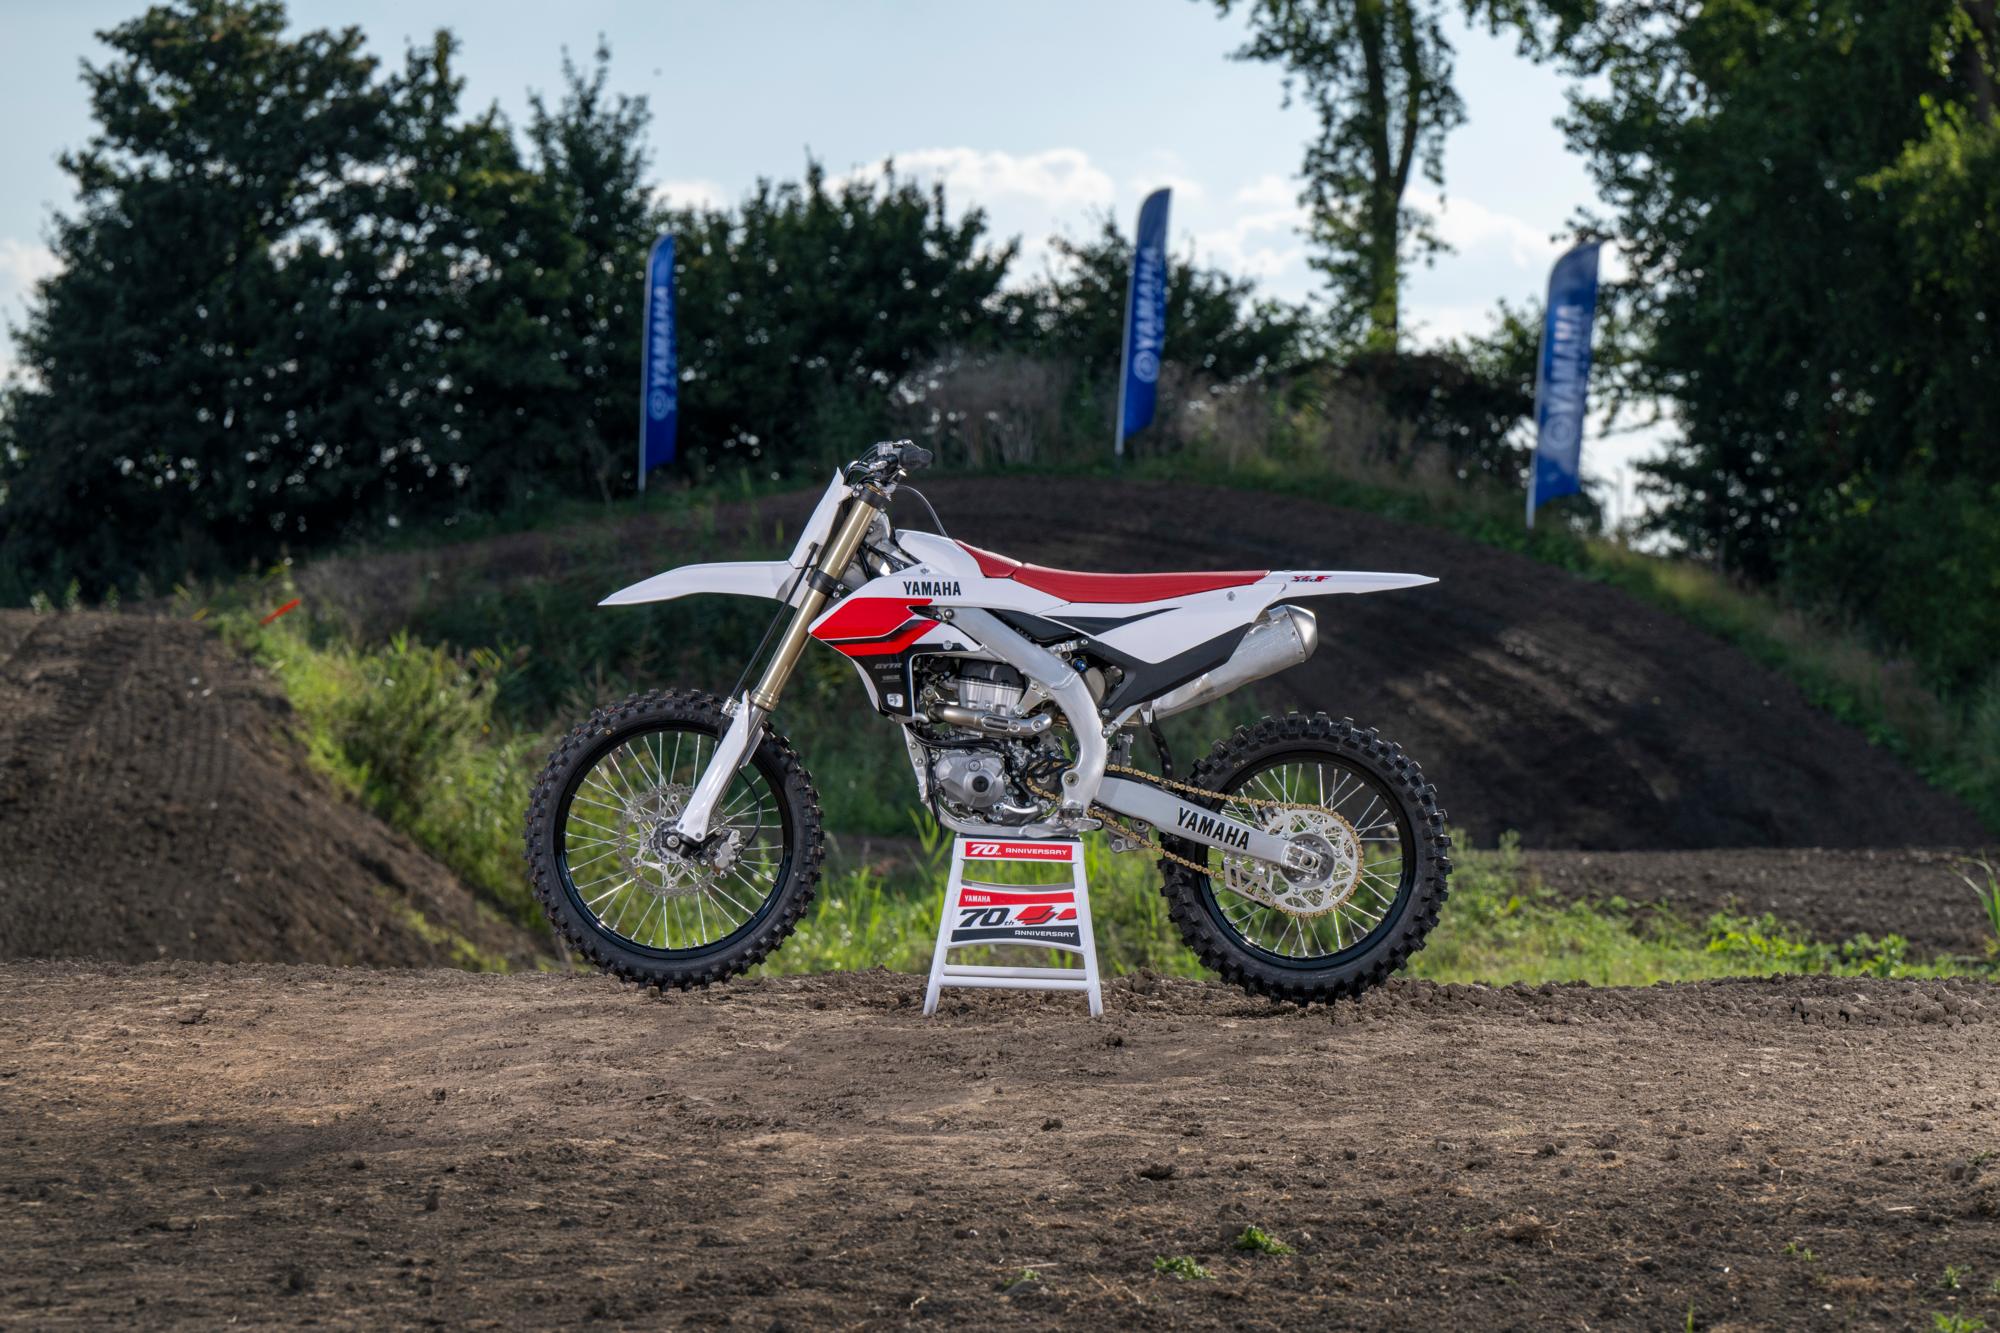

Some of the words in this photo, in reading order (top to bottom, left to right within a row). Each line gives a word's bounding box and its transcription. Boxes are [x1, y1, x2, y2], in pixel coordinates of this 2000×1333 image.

[1136, 247, 1158, 350] YAMAHA
[652, 286, 671, 387] YAMAHA
[1548, 305, 1584, 414] YAMAHA
[903, 581, 962, 596] YAMAHA
[1176, 806, 1250, 850] YAMAHA
[1005, 847, 1068, 856] ANNIVERSARY
[964, 894, 991, 903] YAMAHA
[959, 907, 1015, 928] 70th
[1014, 929, 1075, 938] ANNIVERSARY
